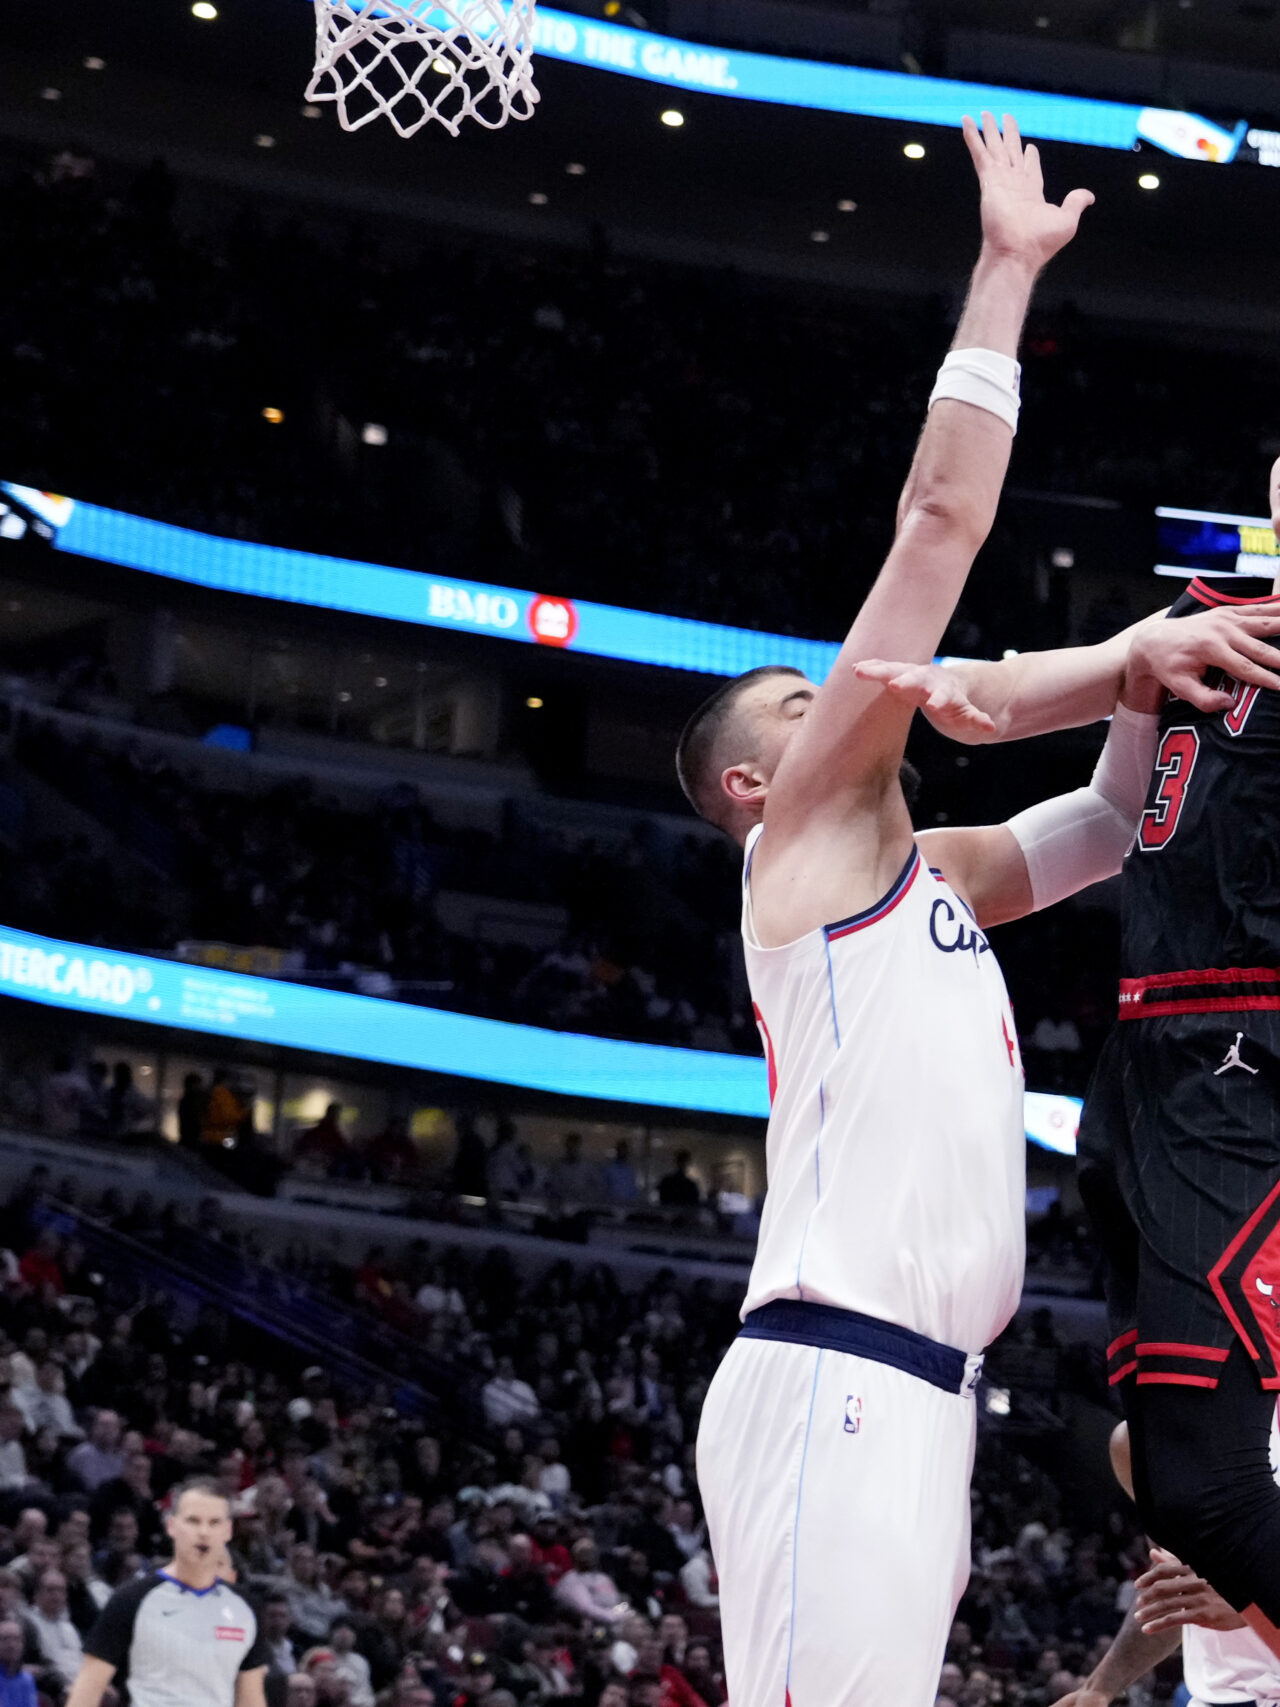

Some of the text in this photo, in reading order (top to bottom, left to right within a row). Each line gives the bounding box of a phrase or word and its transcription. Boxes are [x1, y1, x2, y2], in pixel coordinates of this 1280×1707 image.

[584, 28, 636, 69] THE
[641, 42, 738, 90] GAME.
[427, 583, 520, 628] BMO
